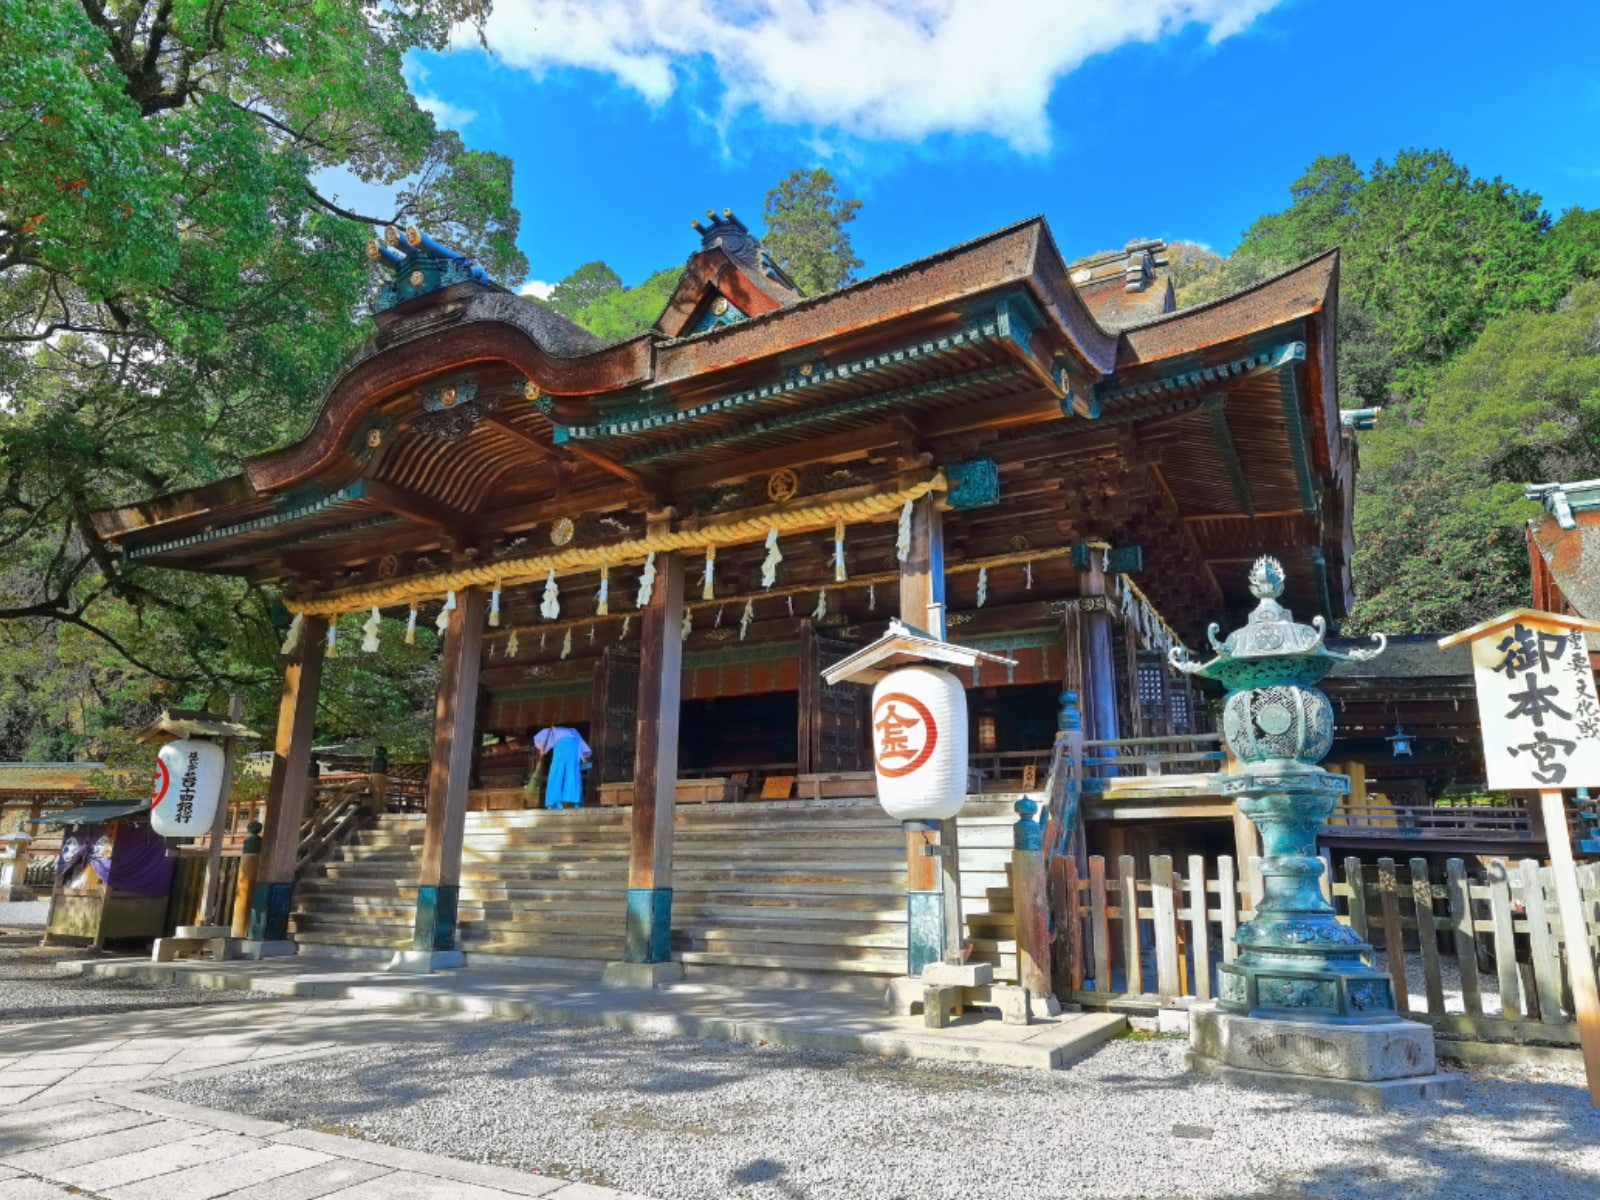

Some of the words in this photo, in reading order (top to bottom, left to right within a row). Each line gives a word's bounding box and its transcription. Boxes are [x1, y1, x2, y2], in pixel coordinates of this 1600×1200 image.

[875, 704, 921, 761] 金
[1491, 623, 1577, 784] 御本宮
[1563, 628, 1600, 742] 重要文化財
